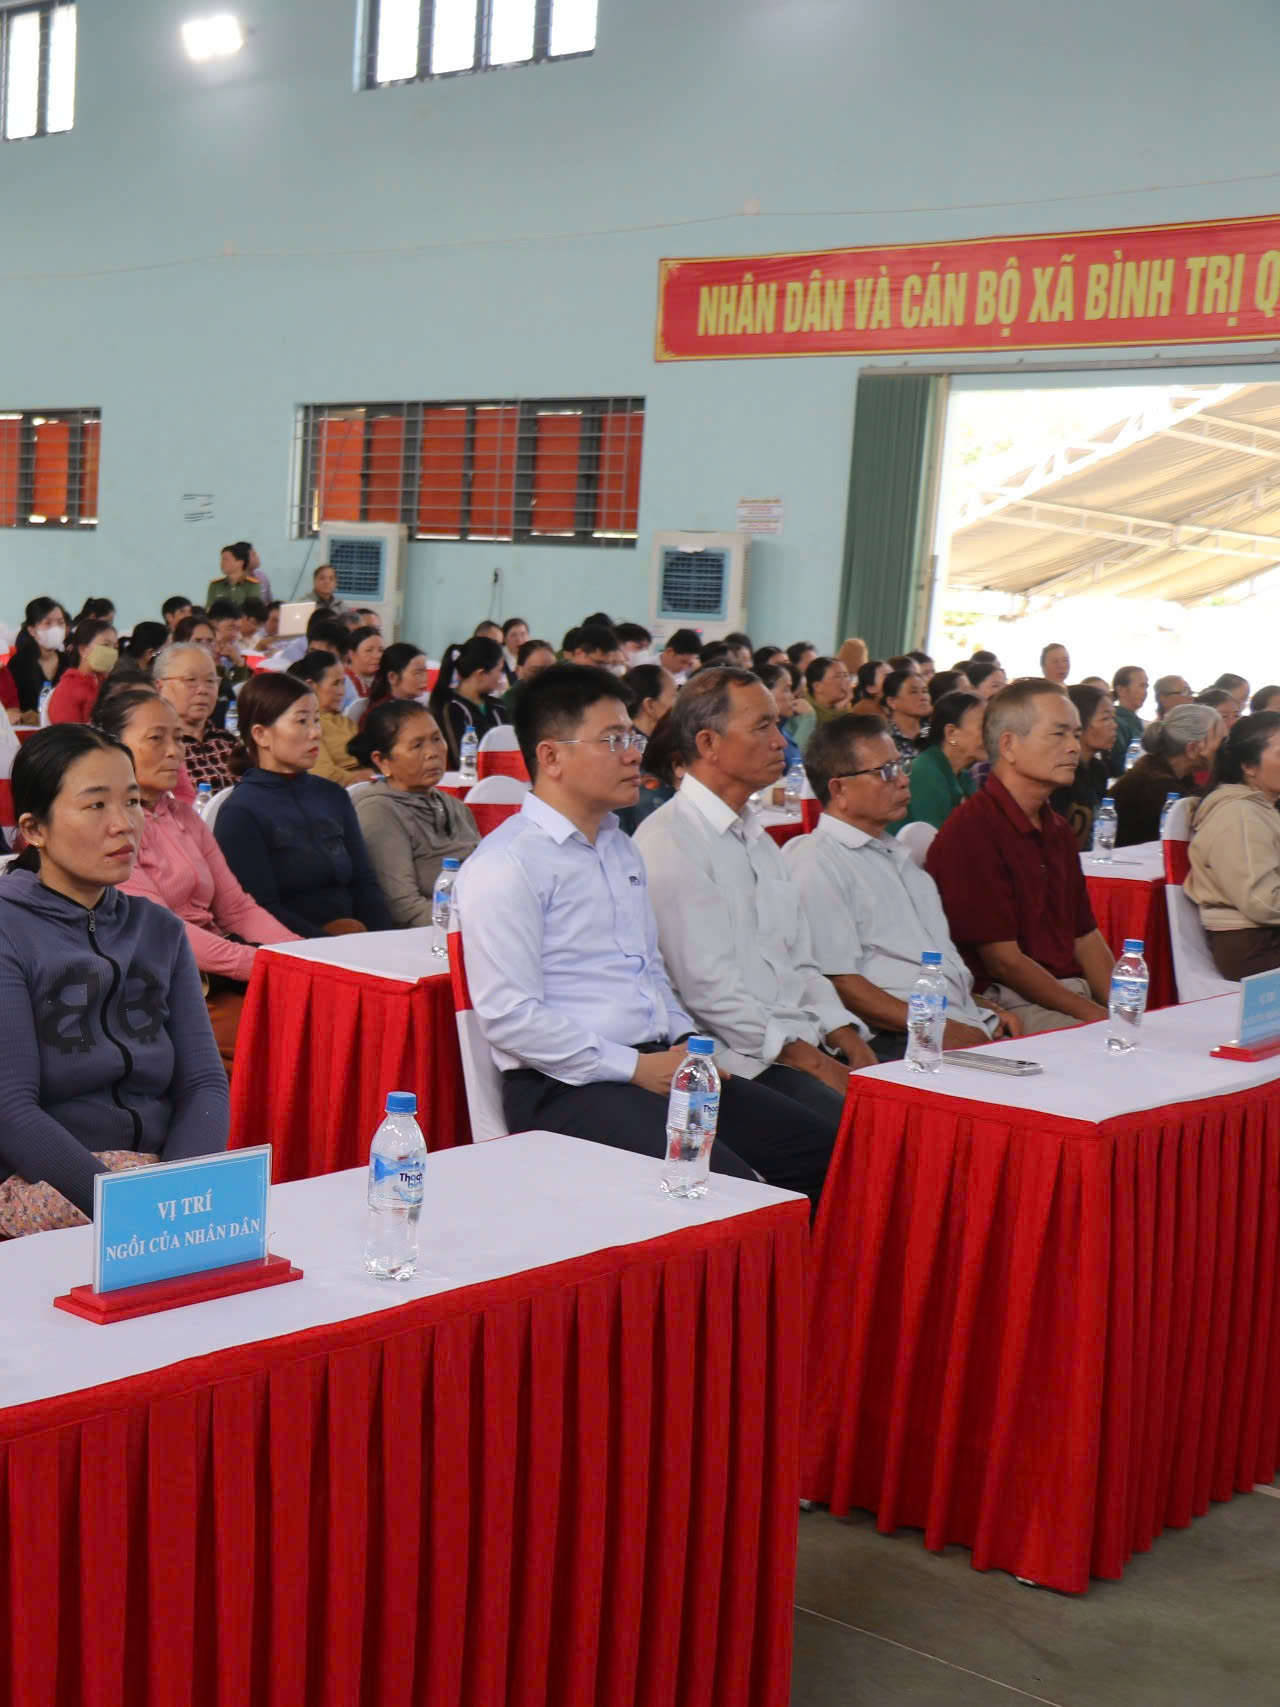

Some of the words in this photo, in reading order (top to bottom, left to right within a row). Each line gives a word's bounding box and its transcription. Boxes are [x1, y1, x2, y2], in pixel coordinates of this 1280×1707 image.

[696, 274, 776, 337] NHÂN
[783, 268, 846, 333] DÂN
[854, 264, 891, 331] VÀ
[900, 261, 967, 328] CÁN
[975, 256, 1021, 337] BỘ
[1027, 253, 1076, 323] XÃ
[1084, 250, 1176, 321] BÌNH
[1185, 253, 1246, 327] TRỊ
[157, 1199, 177, 1222] VỊ
[181, 1188, 213, 1216] TRÍ
[106, 1233, 145, 1262] NGỒI
[149, 1230, 181, 1253] CỦA
[185, 1224, 226, 1247] NHÂN
[229, 1216, 261, 1238] DÂN
